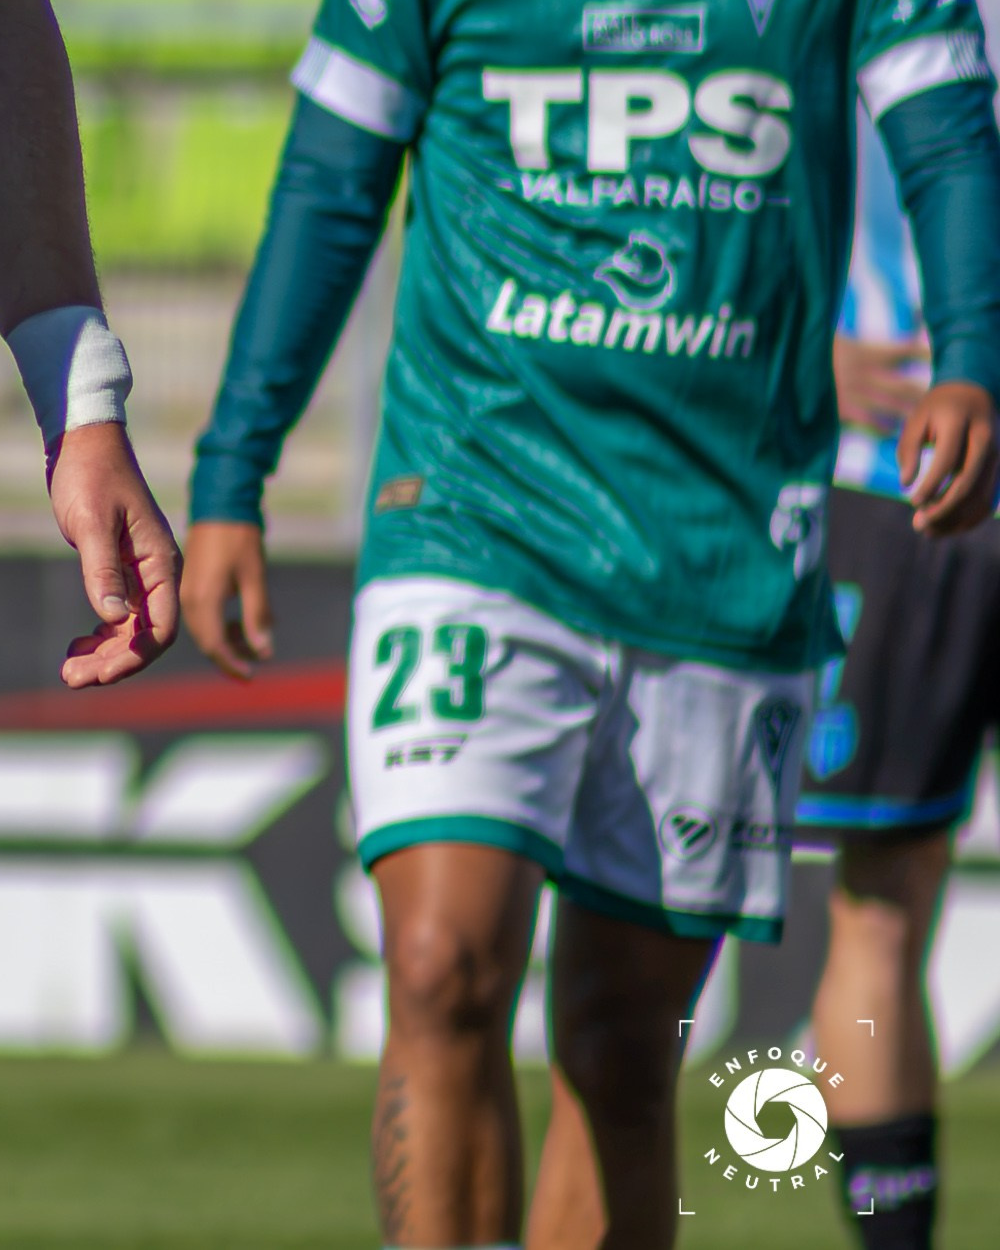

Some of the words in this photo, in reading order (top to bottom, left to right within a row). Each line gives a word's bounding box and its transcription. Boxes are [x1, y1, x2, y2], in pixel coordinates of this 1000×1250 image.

[482, 67, 793, 177] TPS
[486, 278, 757, 359] Latamwin
[371, 622, 488, 730] 23
